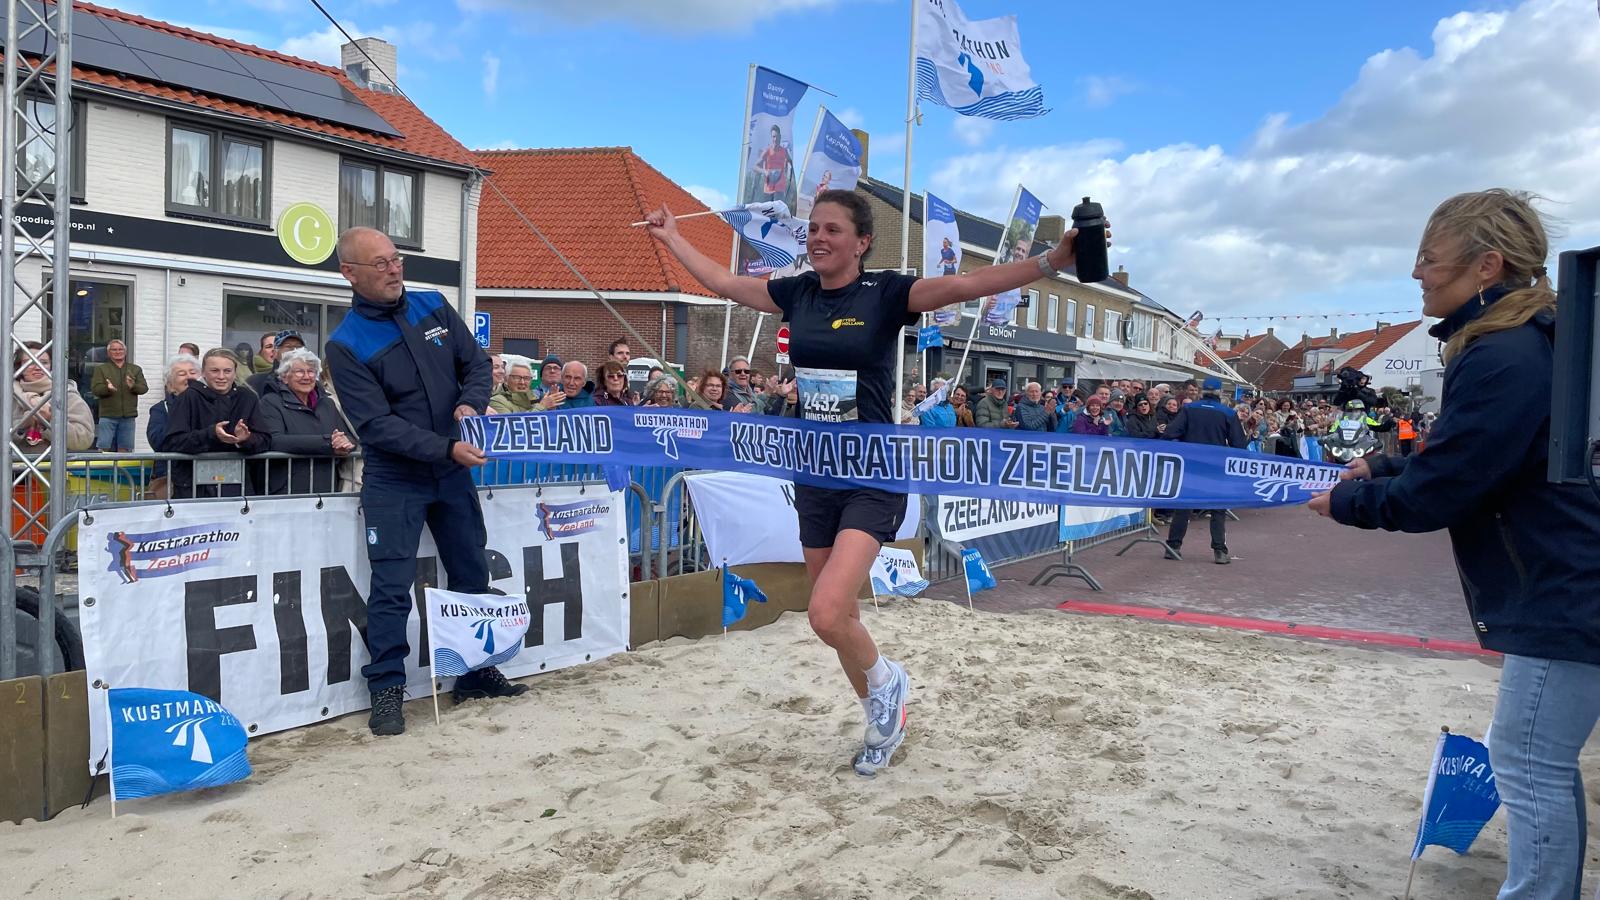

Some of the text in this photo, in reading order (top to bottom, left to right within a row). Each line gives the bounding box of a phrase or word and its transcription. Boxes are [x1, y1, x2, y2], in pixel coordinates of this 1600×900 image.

[14, 215, 96, 231] goodiesop.nl
[475, 315, 486, 333] P
[1385, 359, 1422, 370] ZOUT
[803, 391, 840, 412] 2432
[634, 414, 708, 430] KUSTMARATHON
[491, 415, 613, 454] ZEELAND
[731, 422, 1184, 500] KUSTMARATHON ZEELAND
[1228, 459, 1340, 482] KUSTMARATH
[552, 504, 610, 519] Kustmarathon
[558, 519, 594, 531] Zeeland
[137, 530, 240, 553] Kustmarathon
[147, 549, 210, 571] Zeeland
[15, 682, 26, 704] 2
